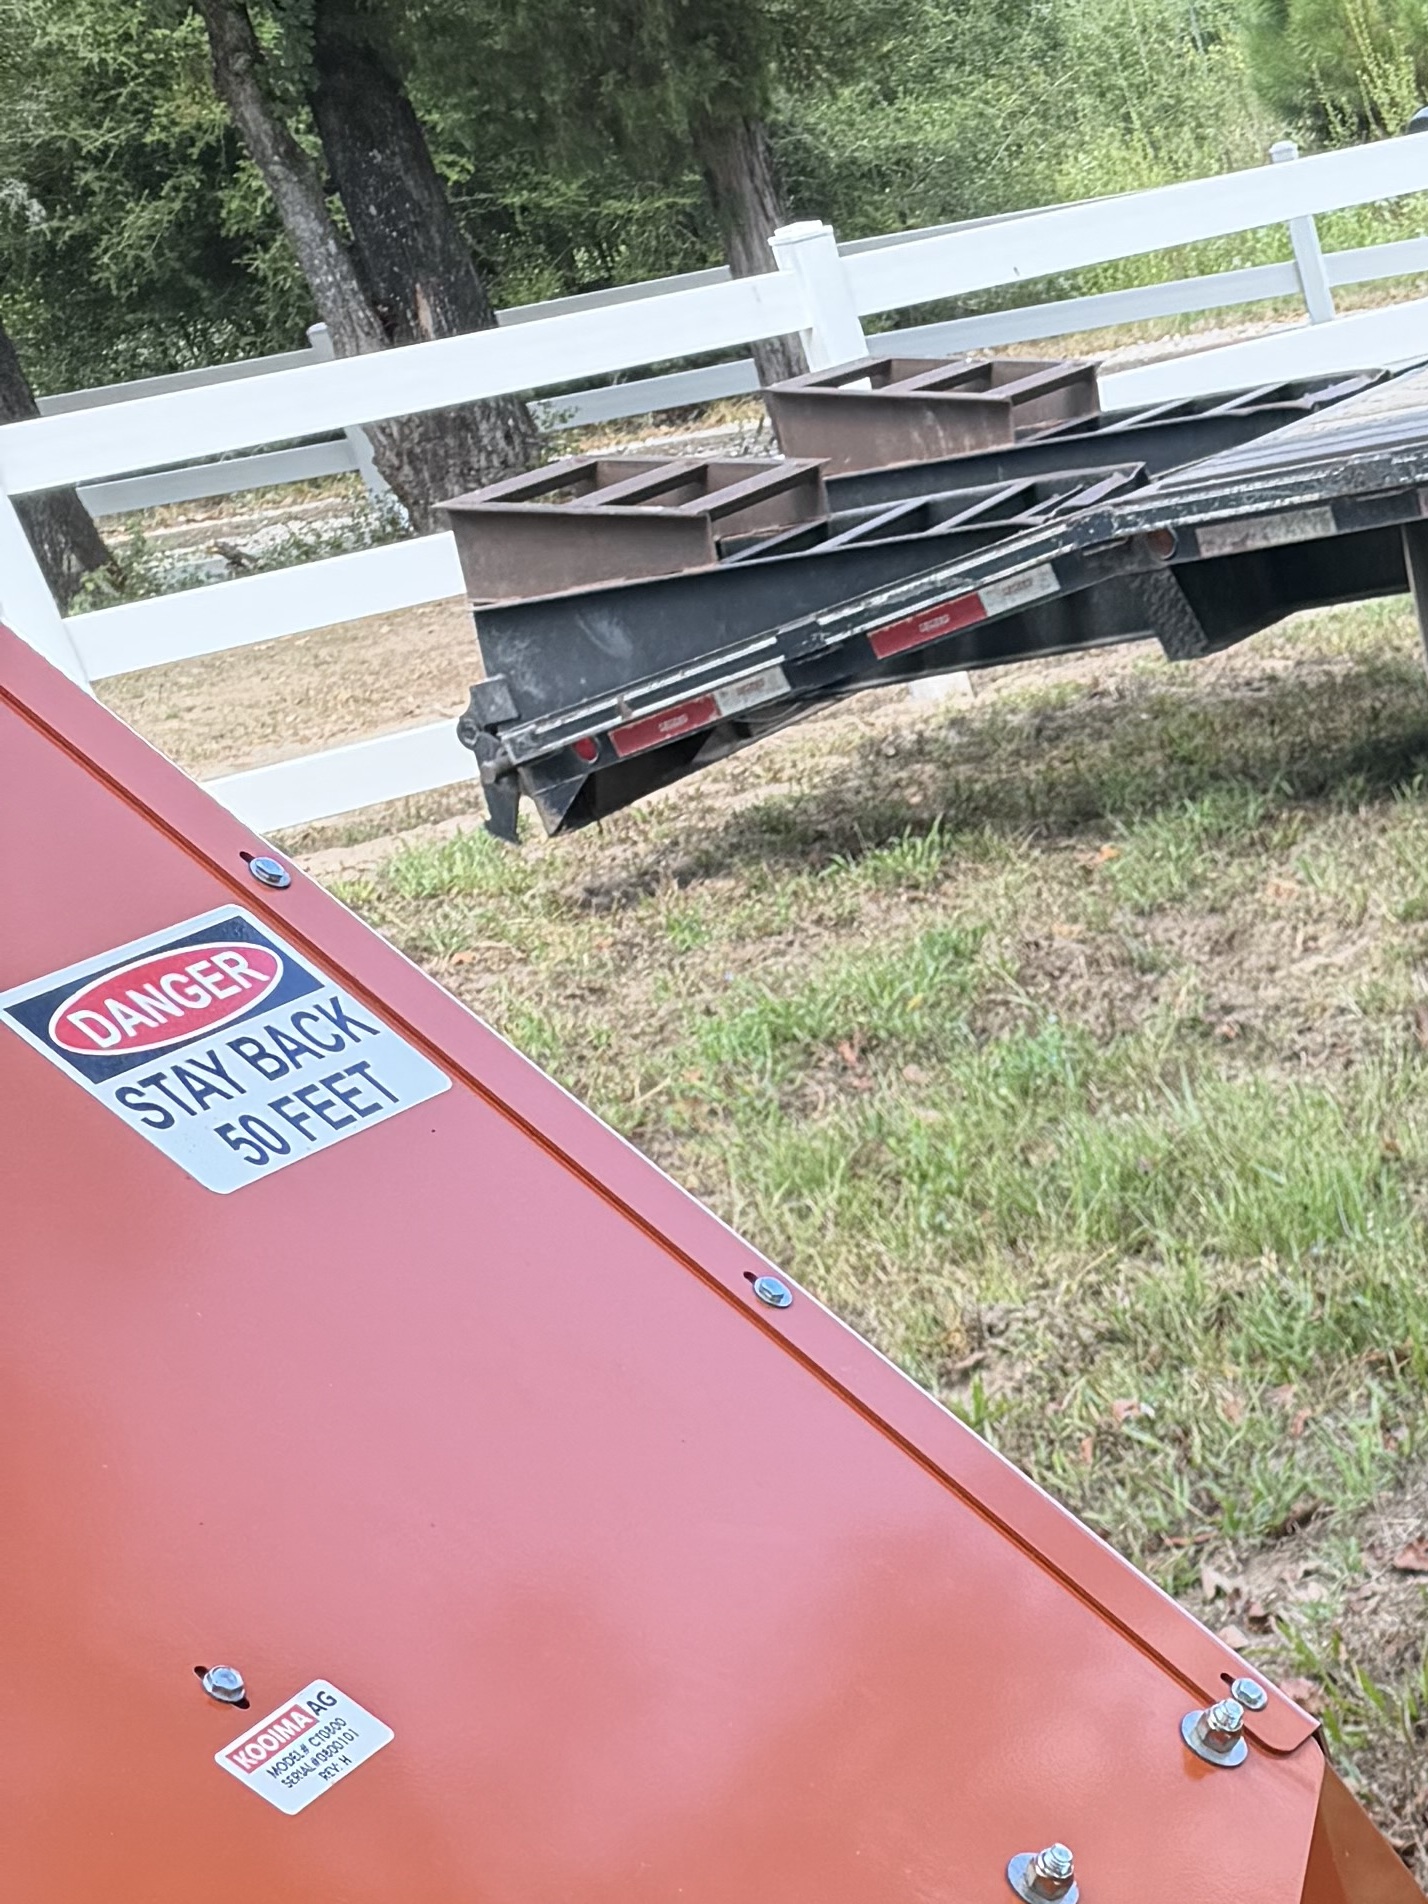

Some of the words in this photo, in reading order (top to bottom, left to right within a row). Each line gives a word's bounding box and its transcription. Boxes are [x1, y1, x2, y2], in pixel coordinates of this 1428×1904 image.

[66, 950, 270, 1049] DANGER
[114, 1049, 247, 1130] STAY
[227, 995, 381, 1081] BACK
[213, 1114, 291, 1166] 50
[268, 1060, 400, 1142] FEET
[233, 1710, 314, 1770] KOOIMA
[306, 1690, 338, 1717] AG
